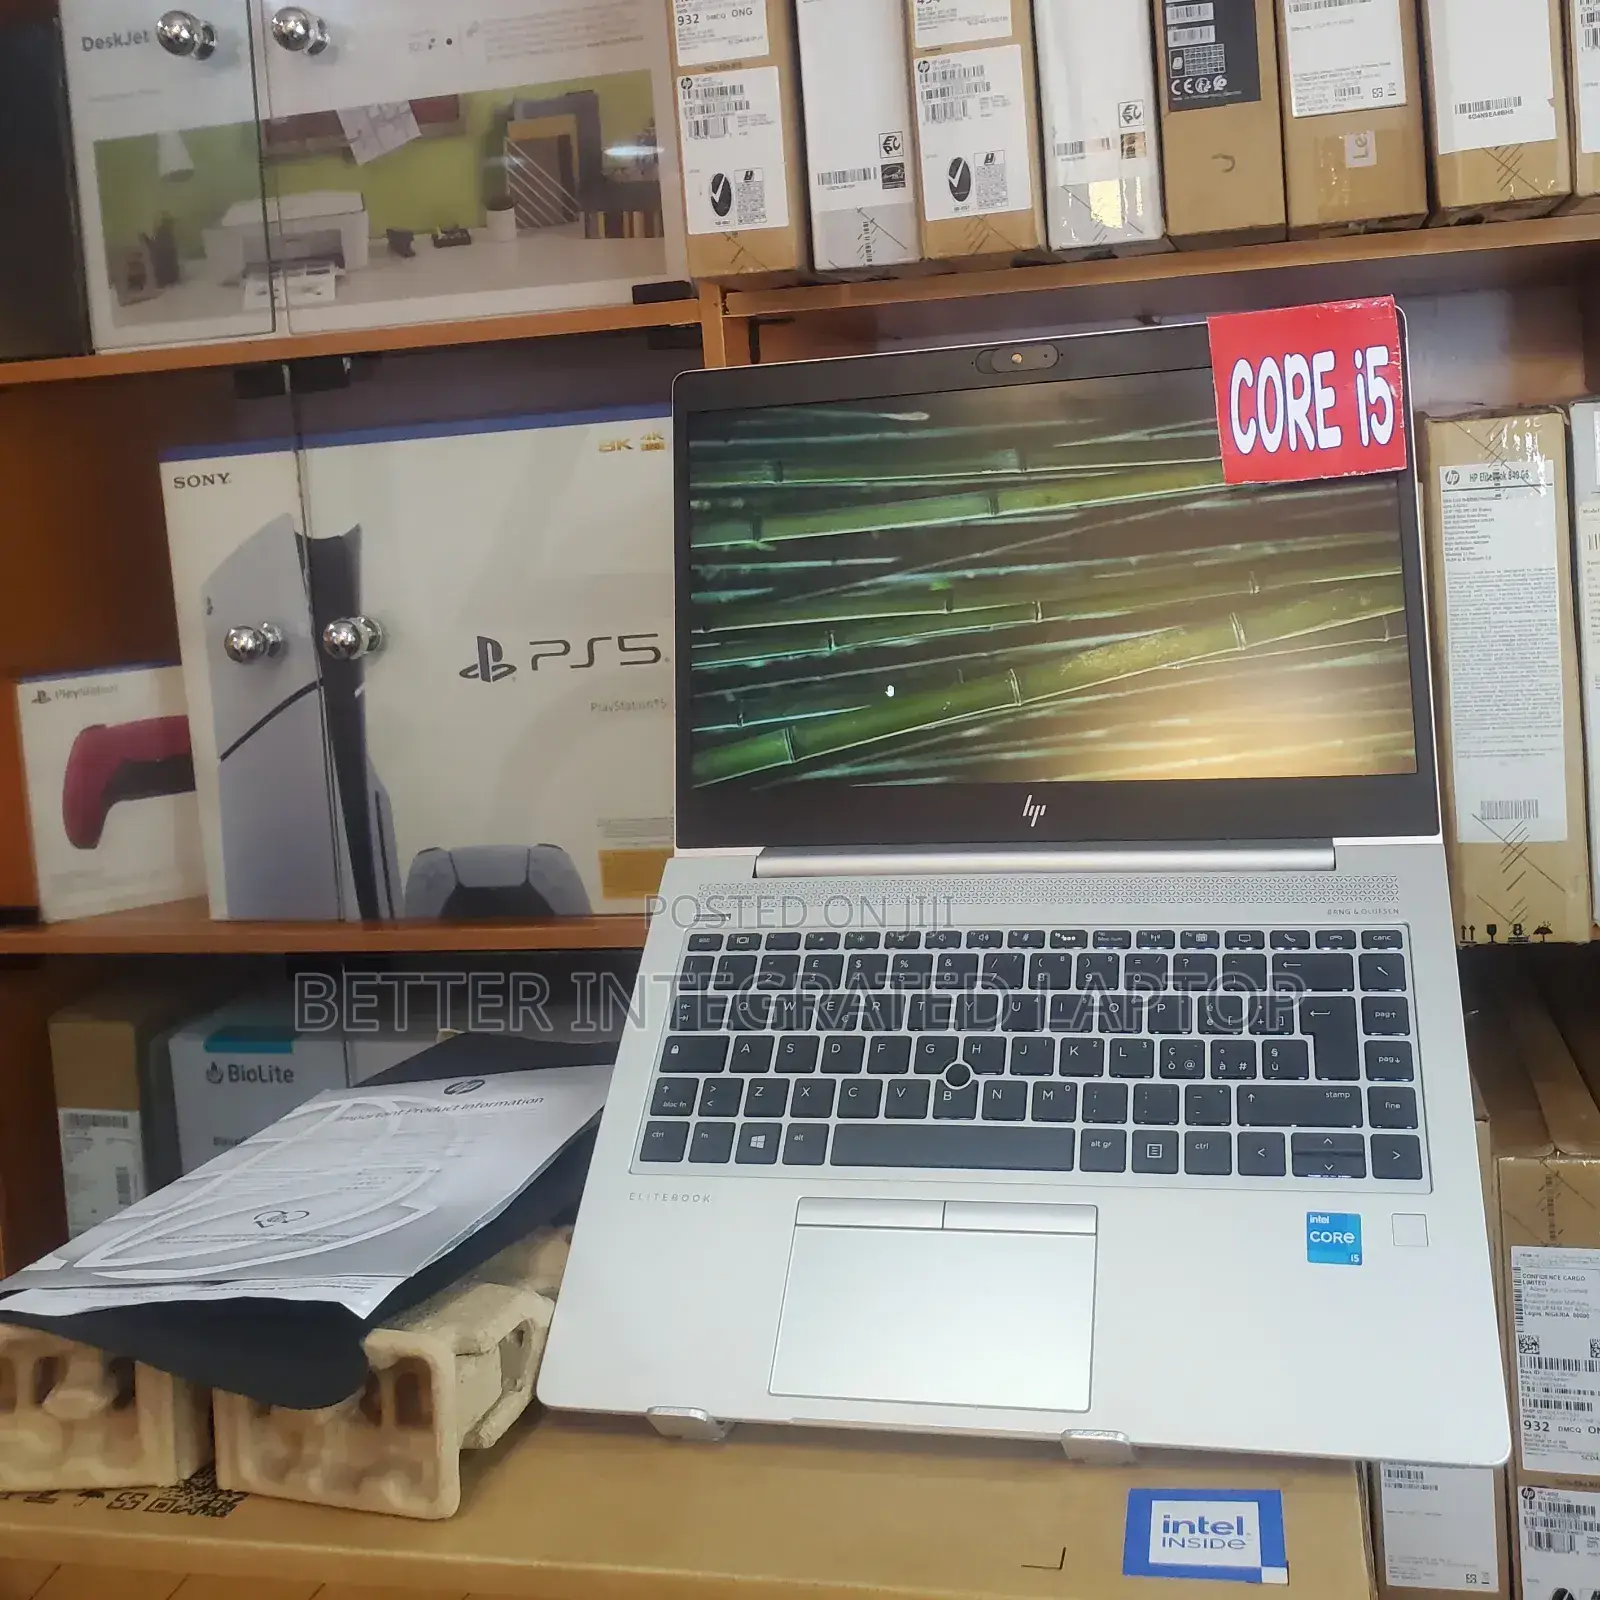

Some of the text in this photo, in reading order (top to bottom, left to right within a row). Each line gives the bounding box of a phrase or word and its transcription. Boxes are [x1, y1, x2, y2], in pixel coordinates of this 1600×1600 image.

[677, 14, 700, 26] 932
[731, 7, 753, 18] ONG
[81, 29, 150, 52] DeskJet
[1230, 345, 1394, 455] CORE i5
[173, 472, 230, 489] SONY
[528, 633, 662, 671] PS5
[855, 959, 862, 969] $
[900, 959, 909, 968] %
[944, 959, 952, 967] &
[1182, 958, 1189, 968] ?
[765, 973, 773, 982] 2
[809, 973, 817, 982] 3
[898, 973, 906, 982] 5
[943, 973, 951, 982] 6
[990, 973, 997, 981] 7
[1037, 973, 1045, 982] 8
[1085, 973, 1093, 982] 9
[738, 1001, 749, 1011] Q
[783, 1001, 796, 1011] W
[826, 1001, 835, 1011] E
[871, 1001, 881, 1011] R
[917, 1001, 925, 1011] T
[964, 1001, 974, 1011] Y
[1011, 1002, 1021, 1012] U
[1109, 1003, 1119, 1013] O
[1157, 1003, 1166, 1013] P
[740, 1043, 750, 1053] A
[786, 1043, 794, 1053] S
[831, 1043, 841, 1053] D
[877, 1044, 886, 1053] F
[925, 1044, 935, 1054] G
[971, 1044, 981, 1054] H
[1020, 1045, 1027, 1055] J
[1069, 1046, 1079, 1056] K
[1092, 1040, 1098, 1048] 2
[1119, 1047, 1127, 1057] L
[1184, 1060, 1195, 1070] @
[1238, 1062, 1247, 1070] #
[227, 1063, 295, 1084] BioLite
[754, 1086, 764, 1096] Z
[801, 1086, 811, 1097] X
[848, 1087, 859, 1097] C
[896, 1087, 906, 1098] V
[943, 1090, 952, 1100] B
[992, 1089, 1002, 1100] N
[1042, 1090, 1053, 1100] M
[1325, 1091, 1351, 1099] stamp
[404, 1103, 463, 1115] Product
[461, 1096, 545, 1110] Information
[679, 1100, 687, 1108] fn
[1385, 1101, 1401, 1109] fine
[793, 1134, 804, 1142] alt
[1102, 1141, 1112, 1149] gr
[1195, 1142, 1209, 1150] ctrl
[629, 1192, 711, 1203] ELITEBOOK
[1309, 1214, 1330, 1224] intel
[1350, 1254, 1360, 1263] i5
[1523, 1420, 1550, 1432] 932
[1558, 1425, 1582, 1434] DMCQ
[1161, 1514, 1246, 1536] intel
